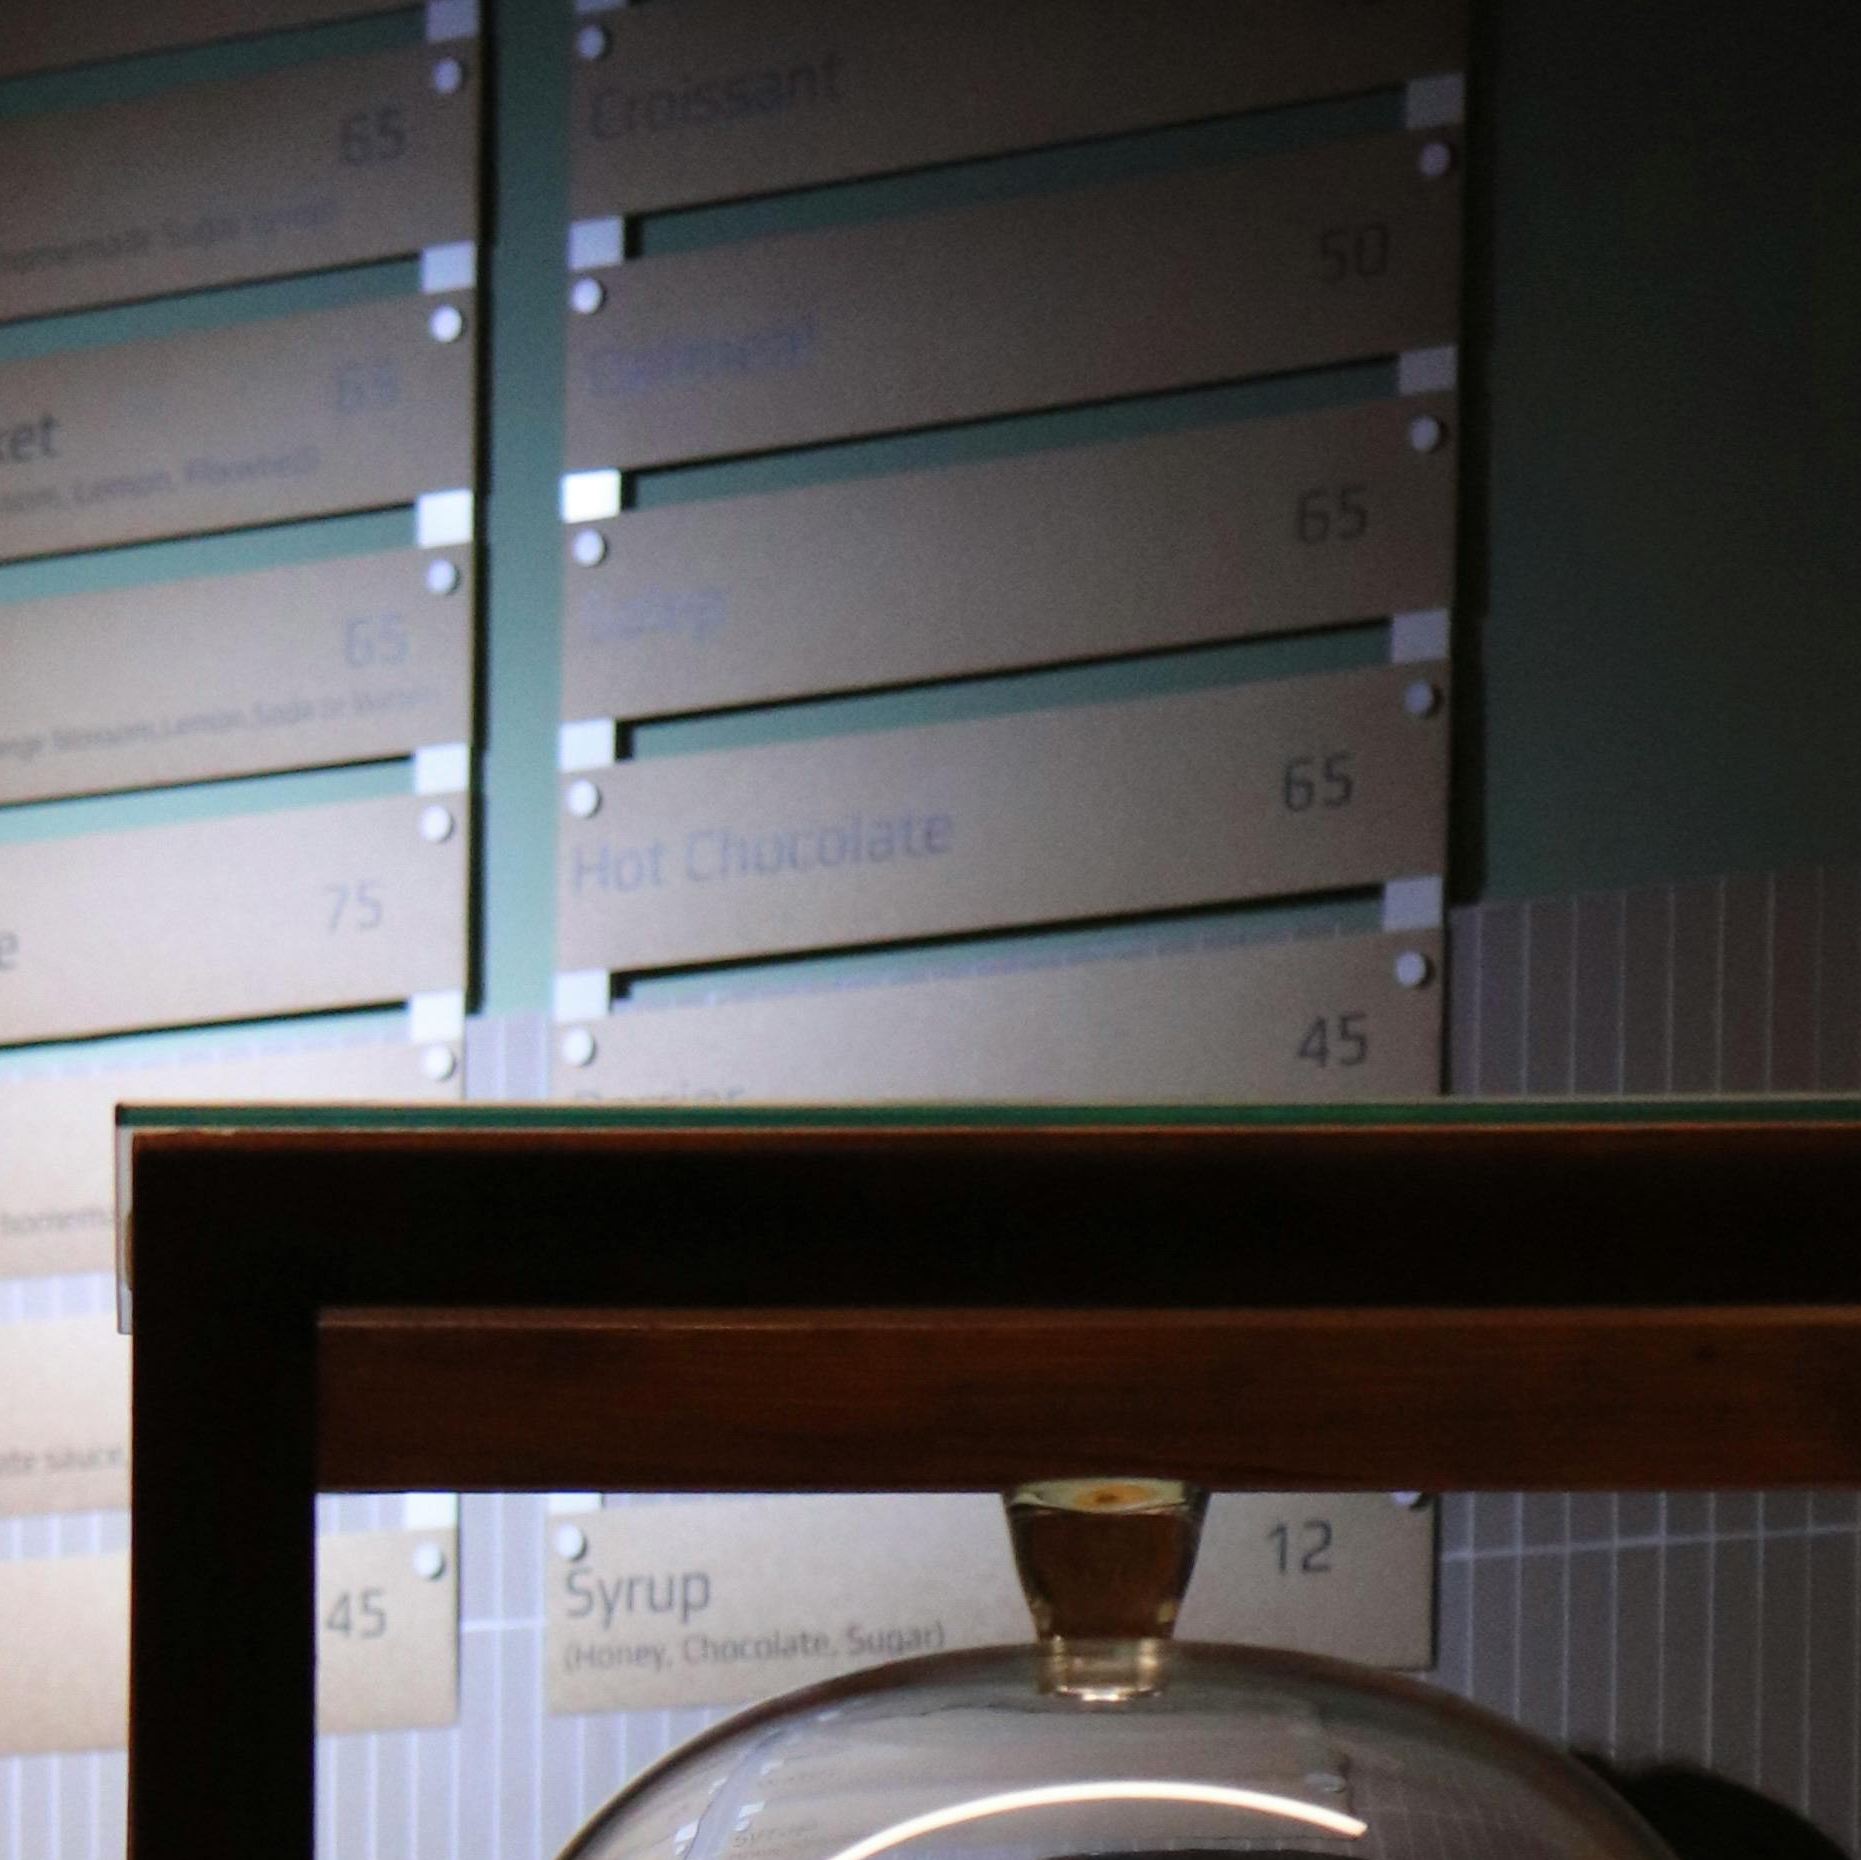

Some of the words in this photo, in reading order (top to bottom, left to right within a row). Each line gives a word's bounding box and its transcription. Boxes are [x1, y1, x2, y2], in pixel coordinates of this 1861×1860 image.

[589, 52, 845, 143] Croissant
[338, 105, 410, 169] 65
[1316, 220, 1392, 286] 50
[1294, 485, 1371, 548] 65
[342, 611, 411, 670] 65
[1281, 752, 1357, 818] 65
[570, 840, 667, 898] Hot
[684, 809, 955, 884] Chocolate
[320, 880, 386, 936] 75
[1295, 1012, 1370, 1070] 45
[562, 1563, 714, 1632] Syrup
[1263, 1517, 1336, 1579] 12
[325, 1585, 388, 1641] 45
[562, 1632, 676, 1675] (Honey,
[846, 1617, 951, 1662] Sugar)
